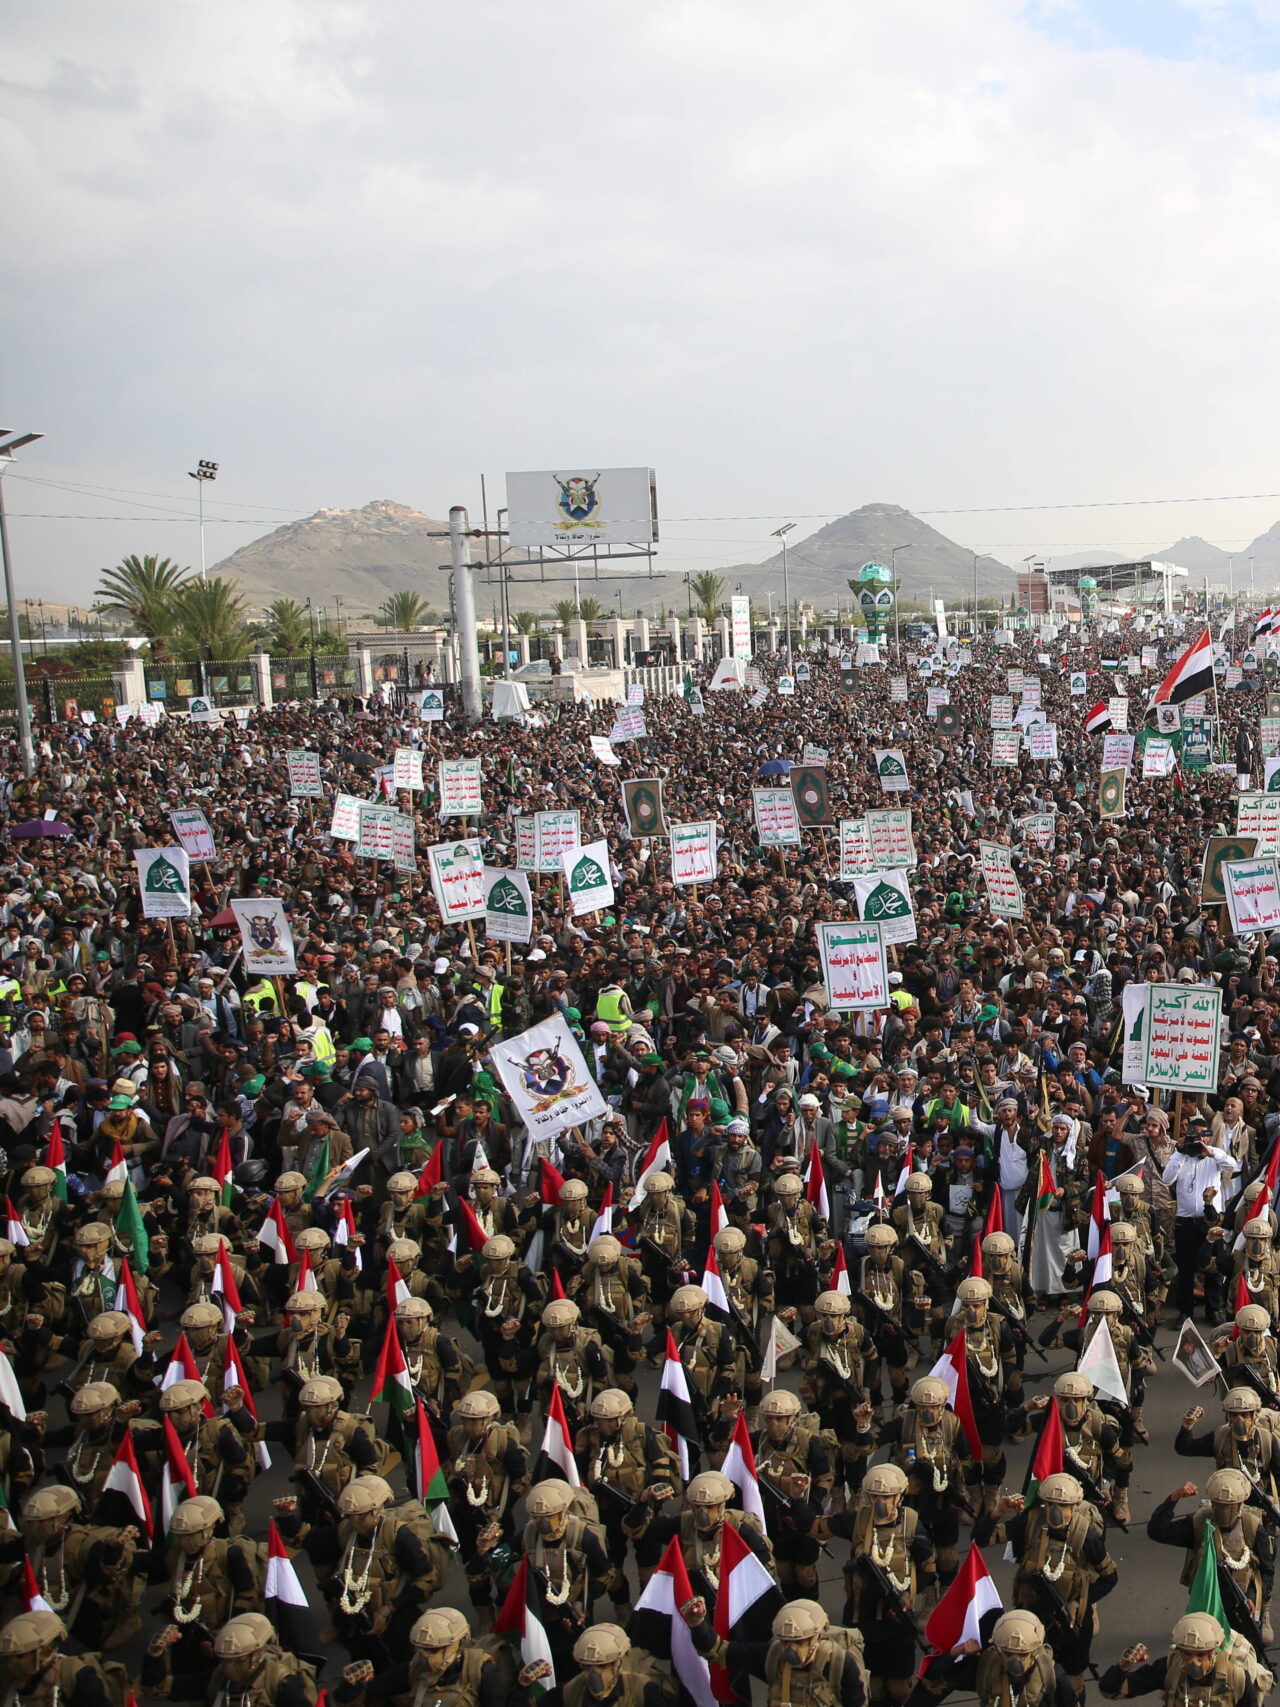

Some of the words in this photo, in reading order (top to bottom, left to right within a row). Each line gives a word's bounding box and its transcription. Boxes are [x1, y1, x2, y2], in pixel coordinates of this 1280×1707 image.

[826, 930, 877, 948] قاطعوا
[829, 951, 855, 967] الأمريكية
[856, 951, 880, 966] البضائع
[852, 970, 857, 980] و
[833, 984, 882, 1001] الإسرائيلية
[1154, 990, 1190, 1012] أكبر
[1192, 996, 1215, 1010] الله
[1153, 1013, 1185, 1026] لأمريكا
[1187, 1018, 1214, 1029] الموت
[1152, 1030, 1184, 1045] لإسرائيل
[1186, 1035, 1213, 1045] الموت
[1151, 1048, 1173, 1060] اليهود
[1176, 1050, 1188, 1061] على
[1191, 1049, 1212, 1061] اللعنة
[1149, 1063, 1180, 1081] للإسلام
[1183, 1065, 1210, 1082] النصر
